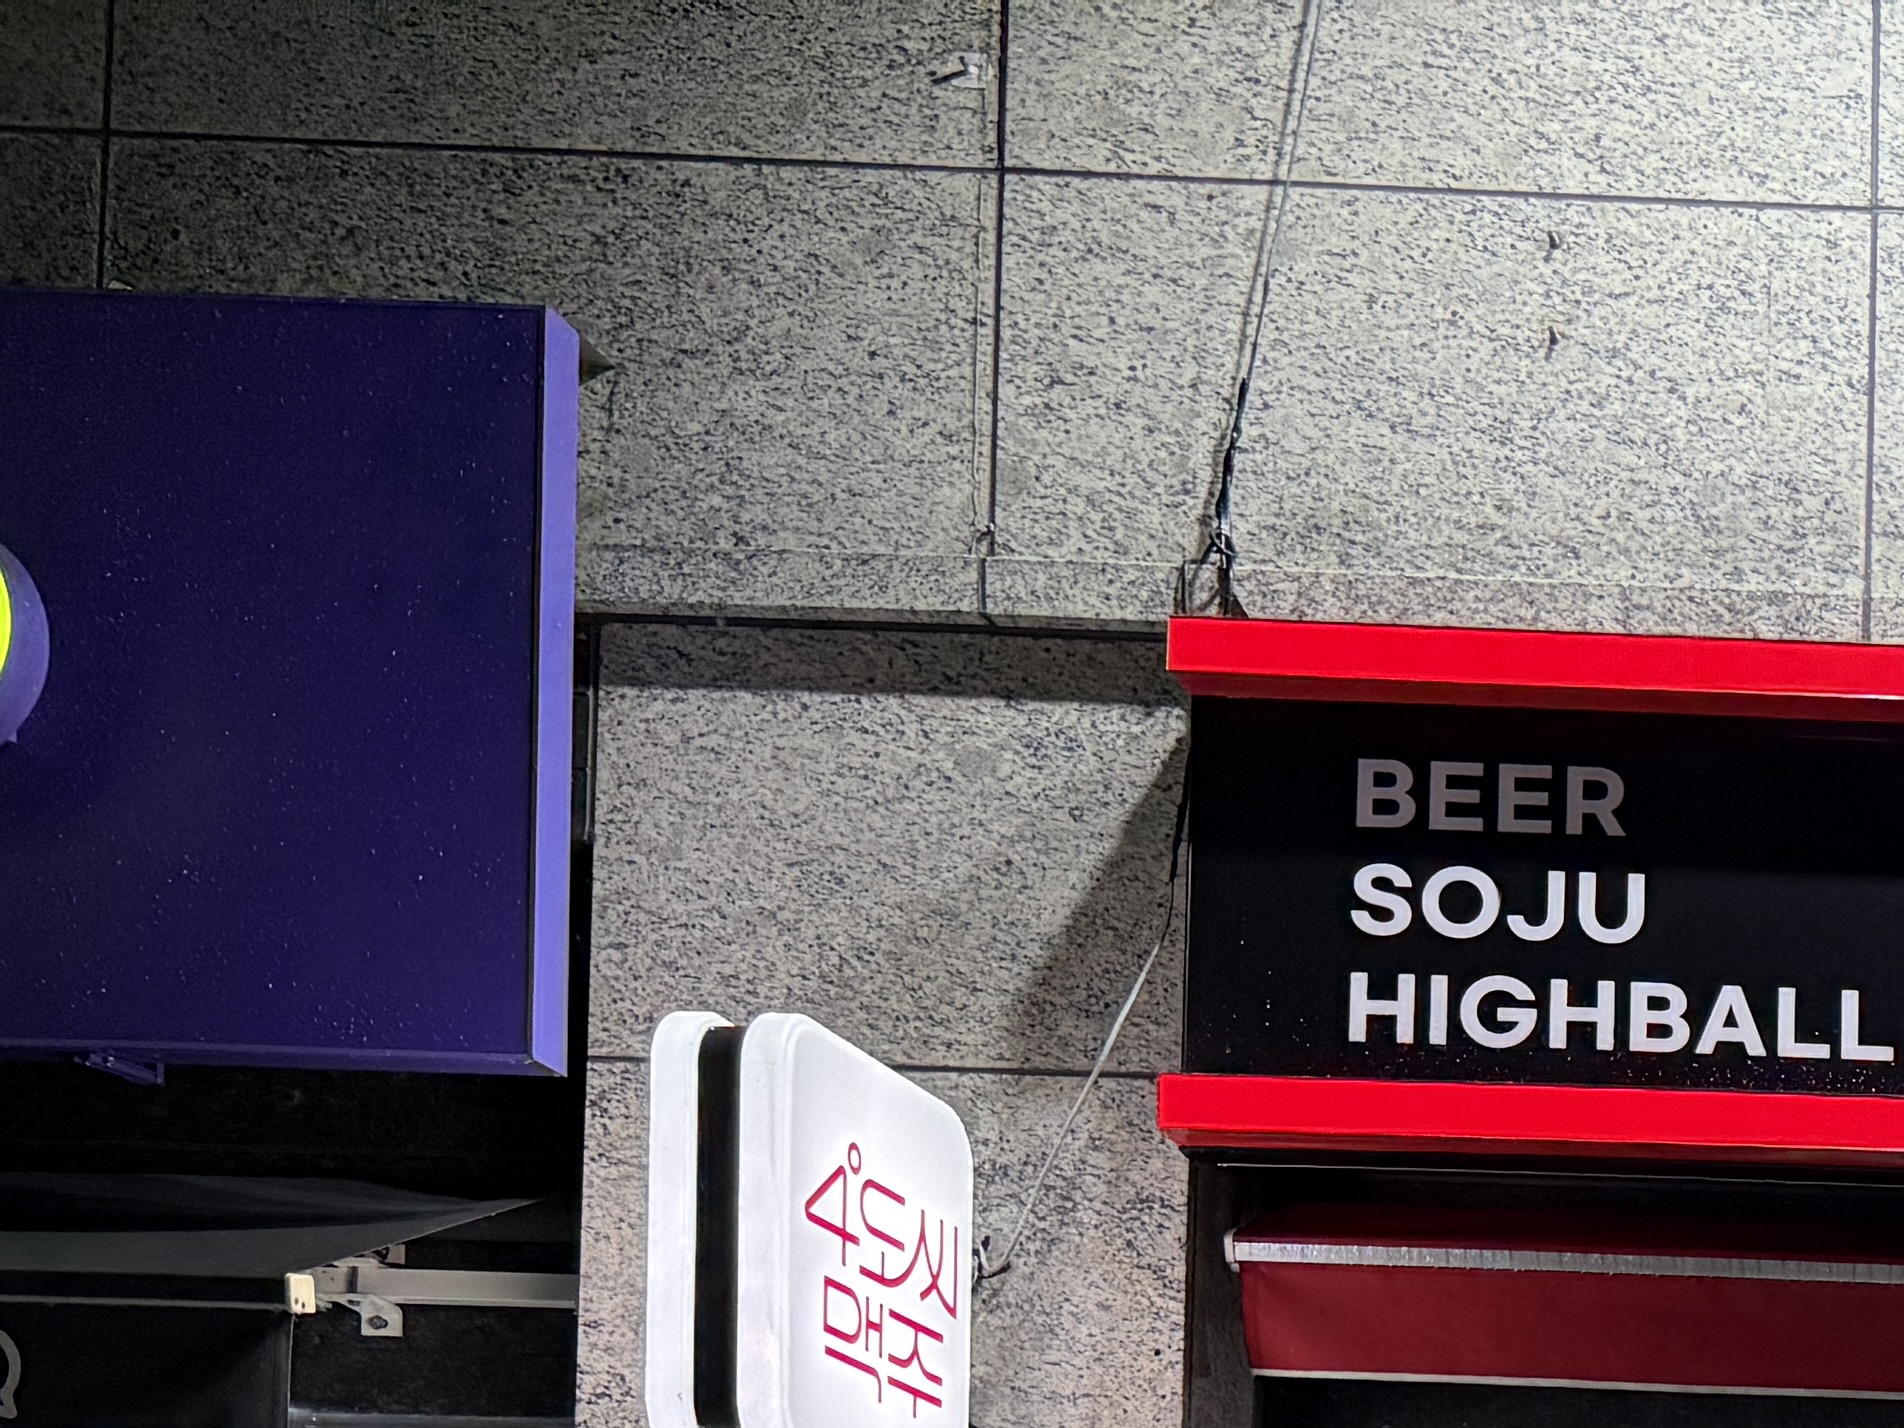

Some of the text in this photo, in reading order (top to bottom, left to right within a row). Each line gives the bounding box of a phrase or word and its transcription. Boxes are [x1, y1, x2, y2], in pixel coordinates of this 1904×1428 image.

[1355, 757, 1627, 836] BEER
[1350, 862, 1646, 945] SOJU
[1348, 972, 1894, 1064] HIGHBALL
[824, 1275, 944, 1418] 맥주
